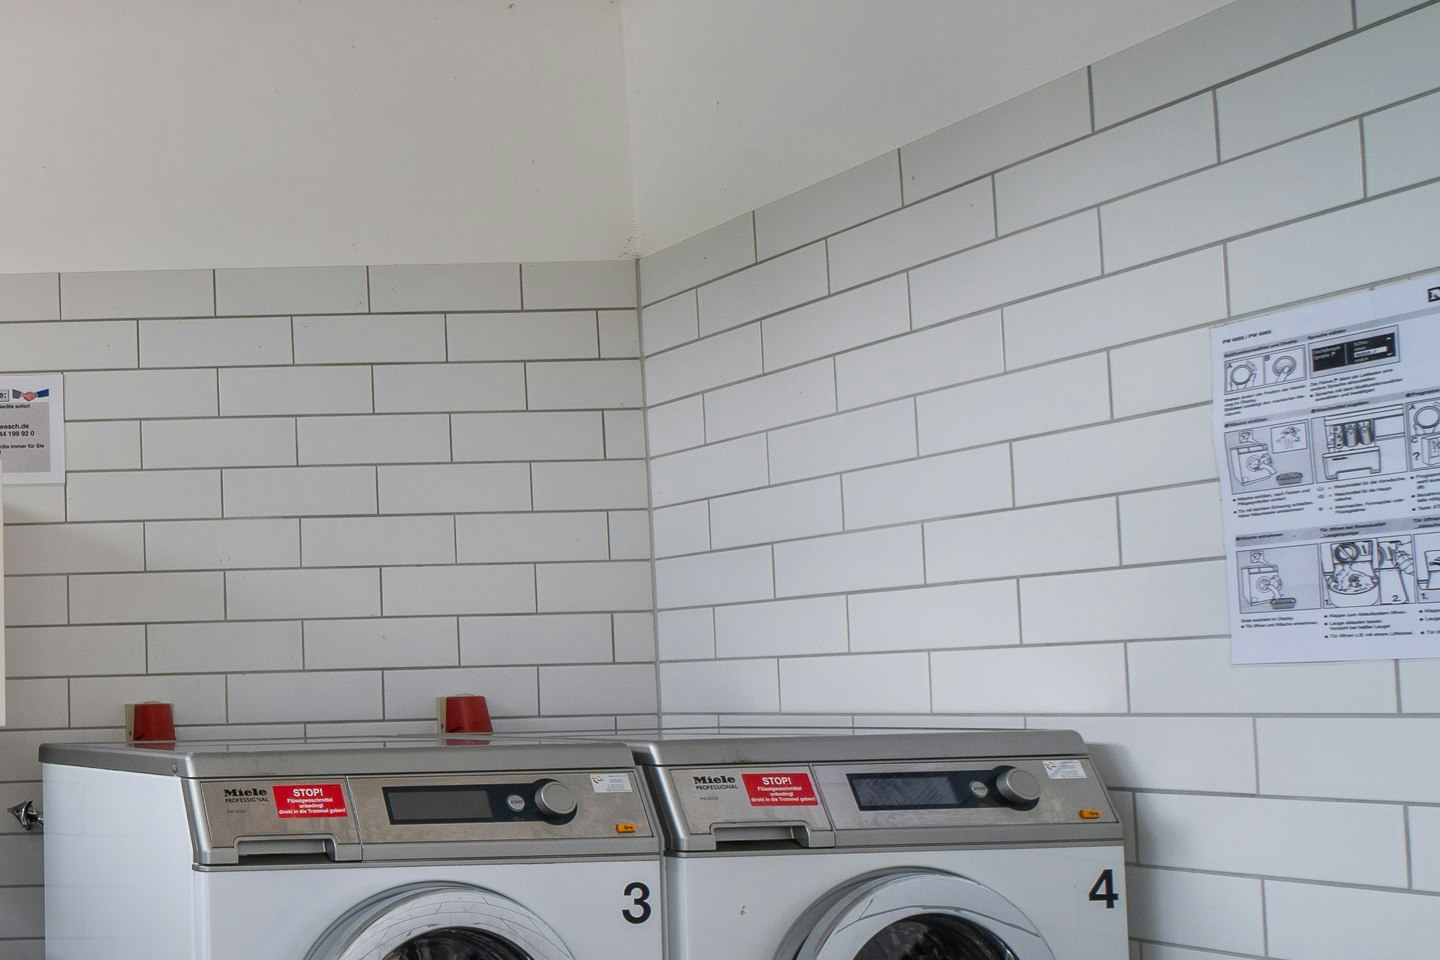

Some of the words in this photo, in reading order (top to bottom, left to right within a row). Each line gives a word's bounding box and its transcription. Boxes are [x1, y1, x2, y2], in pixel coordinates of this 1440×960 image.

[693, 775, 736, 784] Miele
[762, 776, 792, 785] STOP!
[224, 788, 267, 797] Miele
[293, 788, 324, 797] STOP!
[1088, 869, 1119, 909] 4
[622, 882, 651, 924] 3
